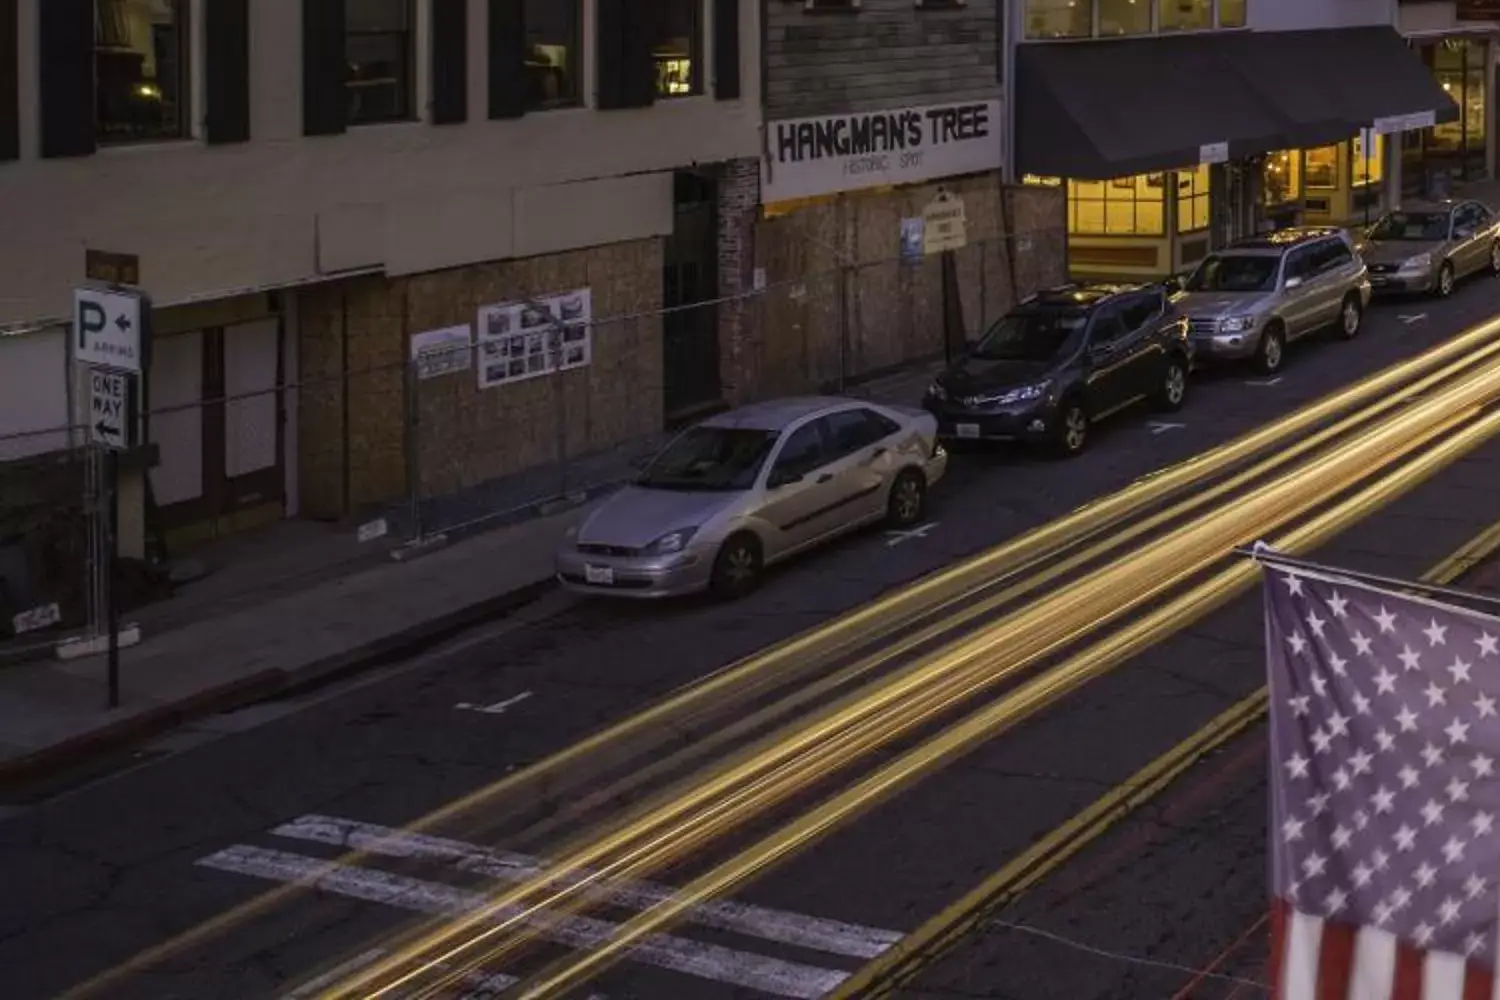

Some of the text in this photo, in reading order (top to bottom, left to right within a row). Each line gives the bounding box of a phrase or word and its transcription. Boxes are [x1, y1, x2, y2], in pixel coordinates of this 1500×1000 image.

[777, 104, 988, 161] HANGMAN'S TREE
[900, 152, 923, 169] SPOT
[93, 375, 122, 397] ONE
[93, 397, 122, 418] WAY
